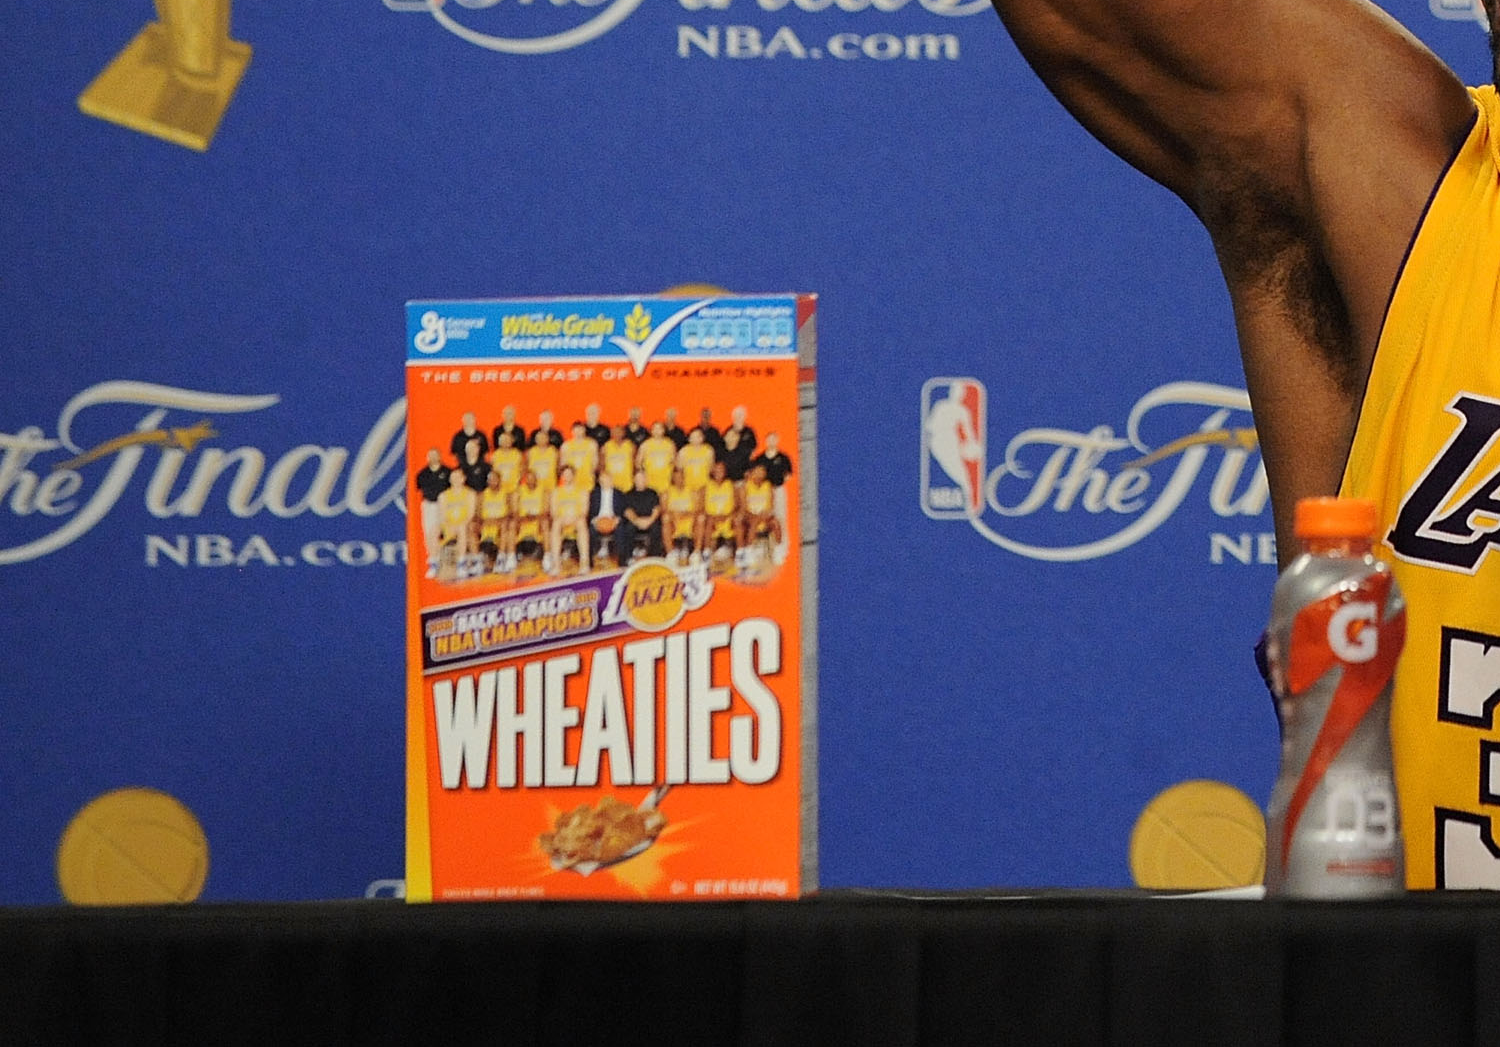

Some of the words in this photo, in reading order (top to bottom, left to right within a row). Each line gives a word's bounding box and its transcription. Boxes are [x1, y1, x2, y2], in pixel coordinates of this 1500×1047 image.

[677, 25, 961, 60] NBA.com
[500, 335, 605, 351] Guaranteed
[501, 314, 563, 337] Whole
[563, 314, 615, 337] Grain
[421, 371, 462, 384] THE
[469, 368, 595, 384] BREAKFAST
[602, 367, 630, 382] OF
[0, 425, 86, 517] he
[57, 379, 408, 565] Final
[986, 426, 1153, 517] The
[435, 631, 475, 656] NBA
[480, 606, 593, 647] CHAMPIONS
[1327, 601, 1379, 664] G
[431, 616, 783, 790] WHEATIES
